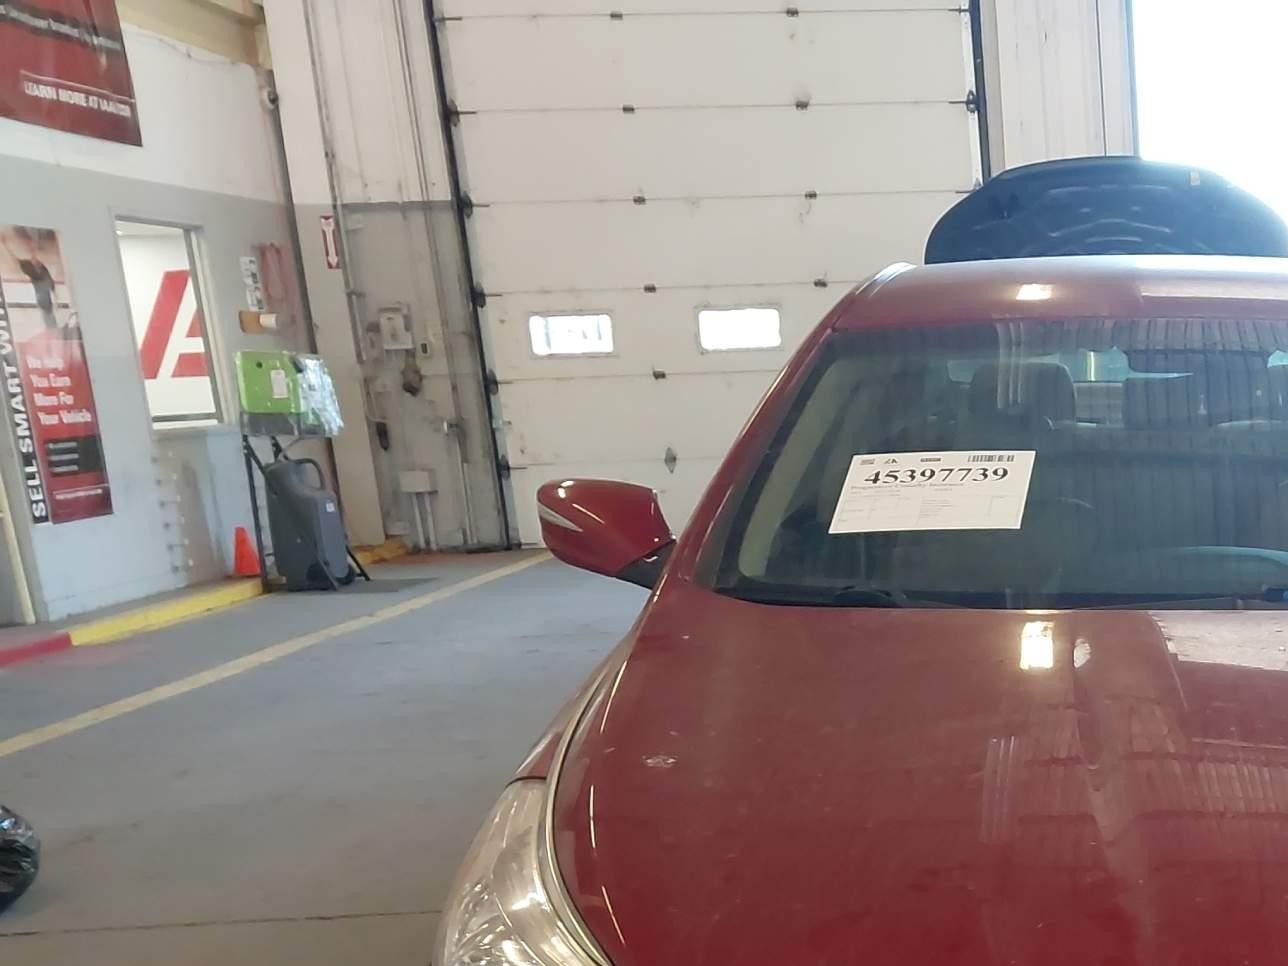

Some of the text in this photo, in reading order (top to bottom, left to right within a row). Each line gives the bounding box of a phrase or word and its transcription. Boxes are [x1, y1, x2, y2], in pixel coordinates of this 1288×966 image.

[3, 361, 34, 454] SMART
[24, 458, 46, 518] SELL
[864, 467, 1008, 484] 45397739
